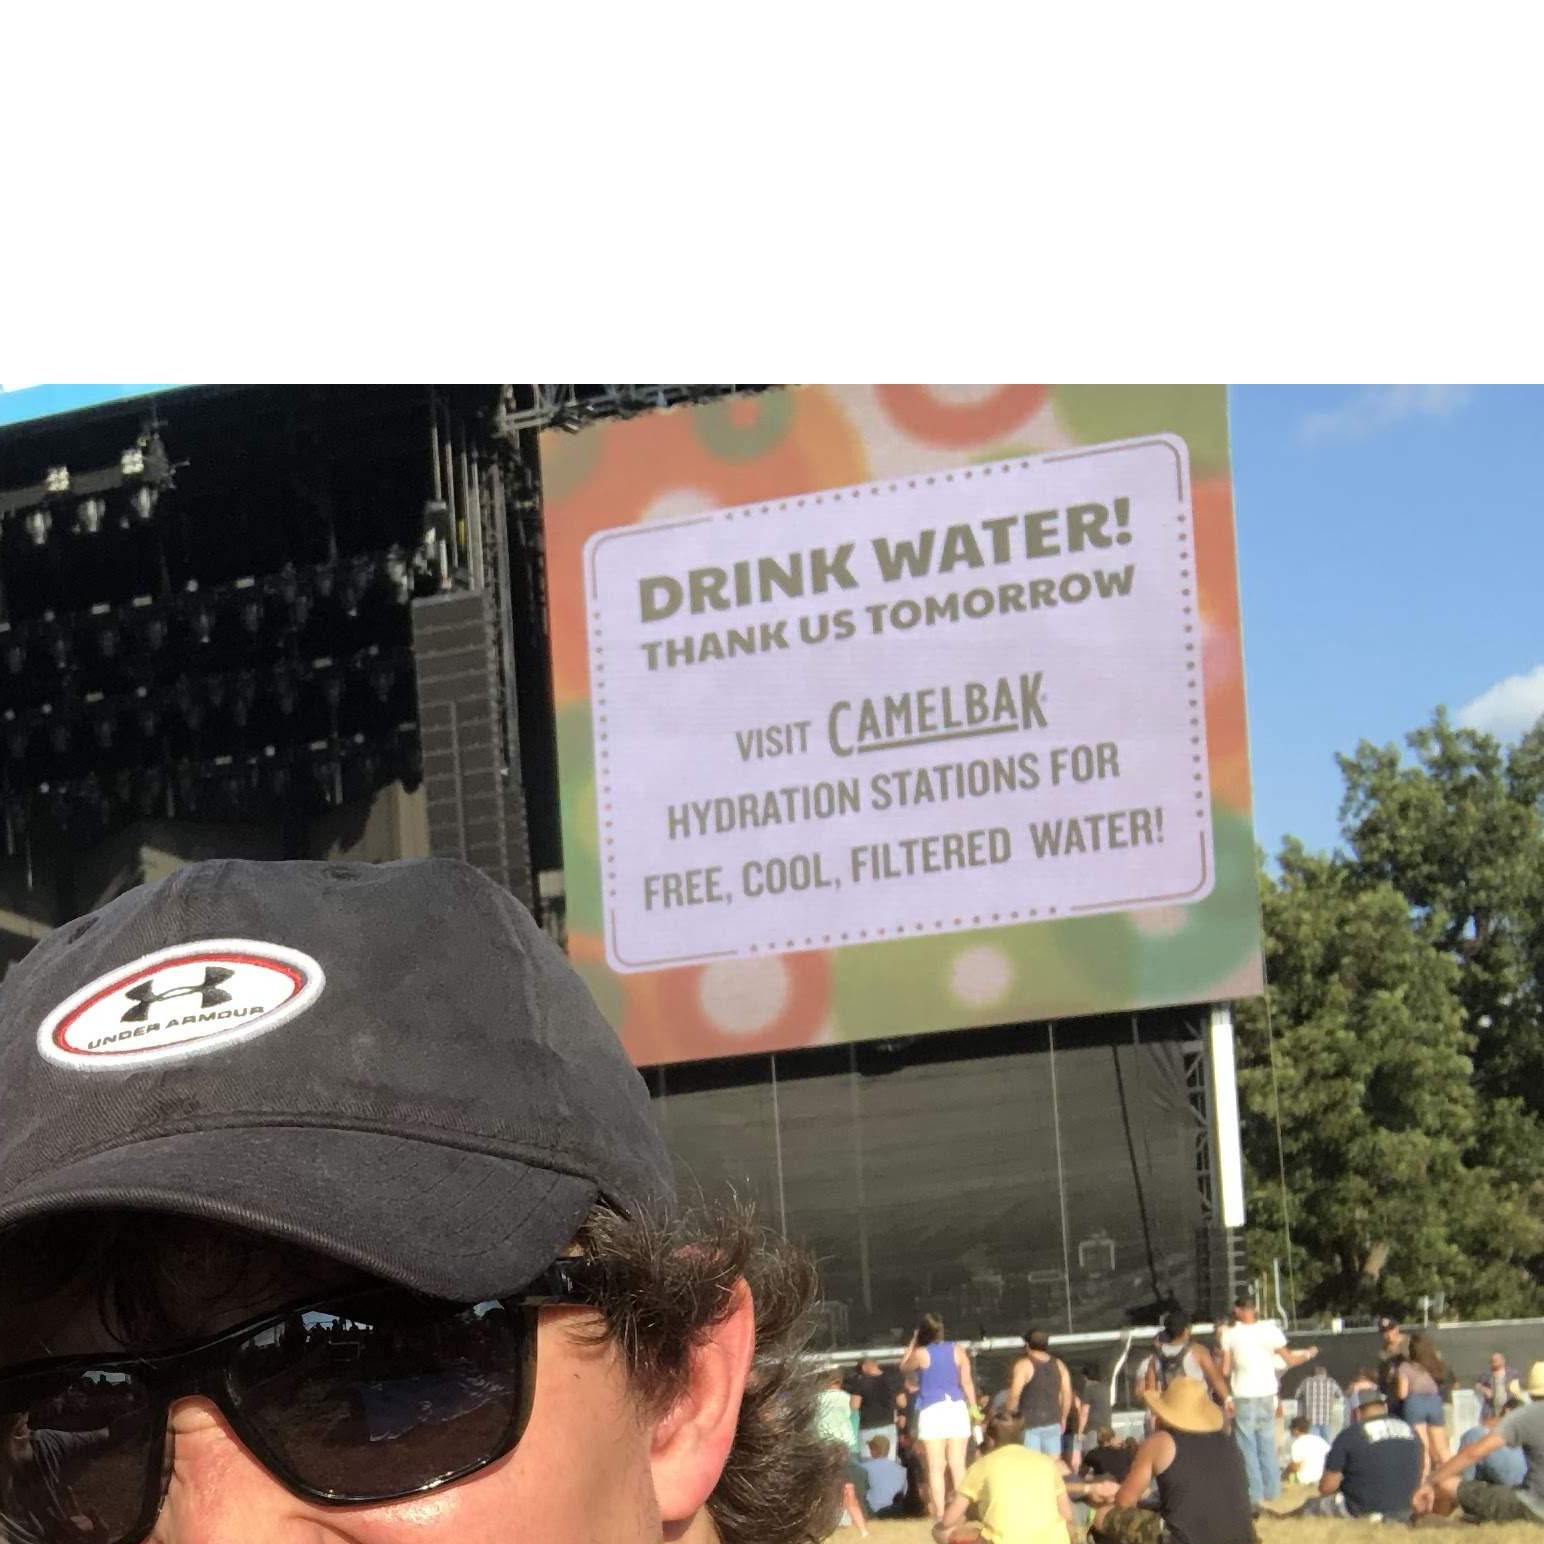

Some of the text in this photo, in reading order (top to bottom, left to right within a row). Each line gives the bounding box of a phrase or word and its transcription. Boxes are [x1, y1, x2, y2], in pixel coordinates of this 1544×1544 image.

[638, 496, 1133, 624] DRINK WATER!
[641, 564, 1135, 671] THANK US TOMORROW
[735, 671, 1048, 762] VISIT CAMELBAK
[667, 741, 1121, 840] HYDRATION STATIONS FOR
[643, 806, 1164, 912] FREE, COOL, FILTERED WATER!
[87, 1006, 265, 1050] UNDER ARMOUR
